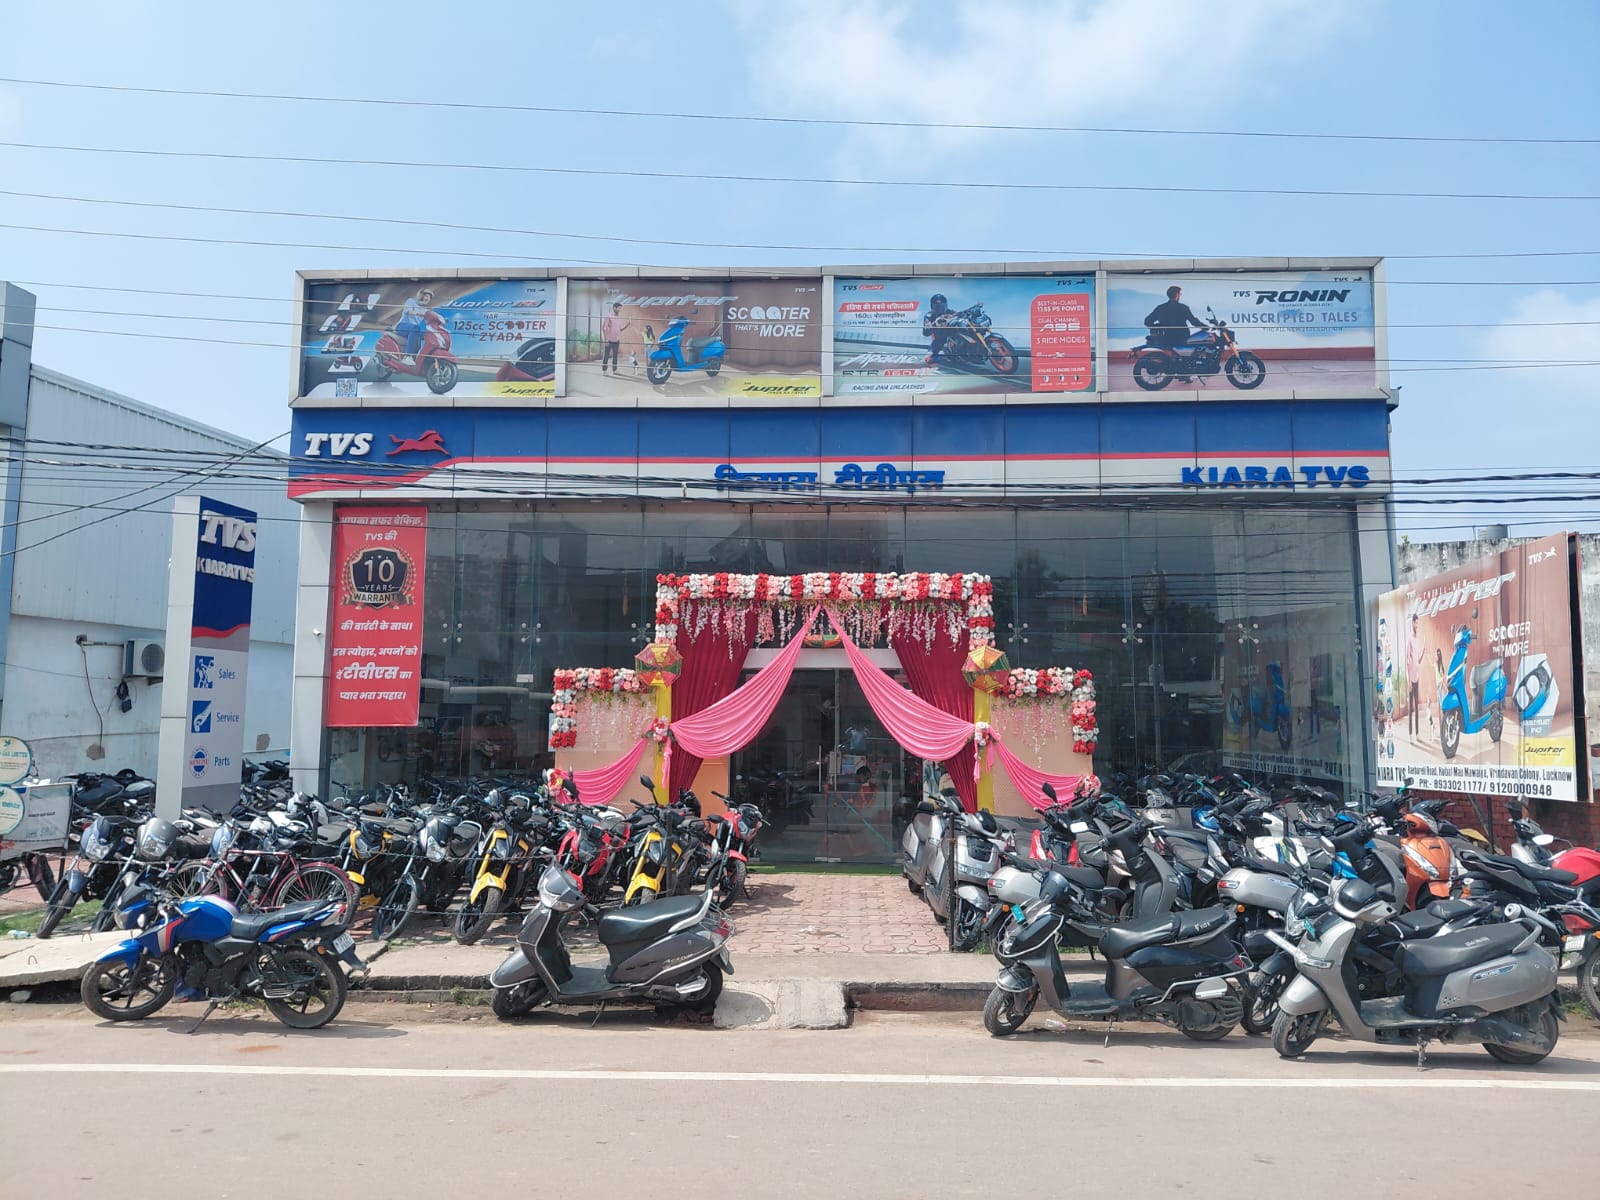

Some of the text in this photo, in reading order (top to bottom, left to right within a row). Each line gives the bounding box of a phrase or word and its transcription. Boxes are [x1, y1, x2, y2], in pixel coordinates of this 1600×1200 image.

[1254, 290, 1351, 305] RONIN
[727, 306, 811, 320] SCOOTER
[1231, 311, 1358, 324] UNSCRIPTED TALES
[453, 320, 547, 331] 125cc SCOOTER
[760, 324, 806, 337] MORE
[480, 332, 523, 342] ZYADA
[1042, 336, 1058, 344] RIDE
[1059, 335, 1086, 343] MODES
[742, 385, 816, 393] Jupiter
[304, 432, 374, 456] TVS
[1181, 465, 1370, 488] KIARA TVS
[201, 509, 257, 553] TVS
[364, 529, 398, 541] TVS की
[1528, 552, 1543, 565] TVS
[364, 559, 395, 582] 10
[364, 584, 393, 592] YEARS
[341, 619, 354, 631] की
[354, 619, 379, 631] वारंटी
[379, 619, 390, 631] के
[1488, 620, 1531, 642] SCOOTER
[1505, 640, 1529, 657] MORE
[218, 668, 236, 680] Sales
[343, 662, 399, 680] टीवीएस
[399, 671, 413, 680] का
[216, 712, 240, 723] Service
[1525, 746, 1566, 754] Jupiter
[214, 756, 230, 767] Parts
[1543, 769, 1572, 782] Lucknow
[1489, 782, 1552, 796] 9120000948
